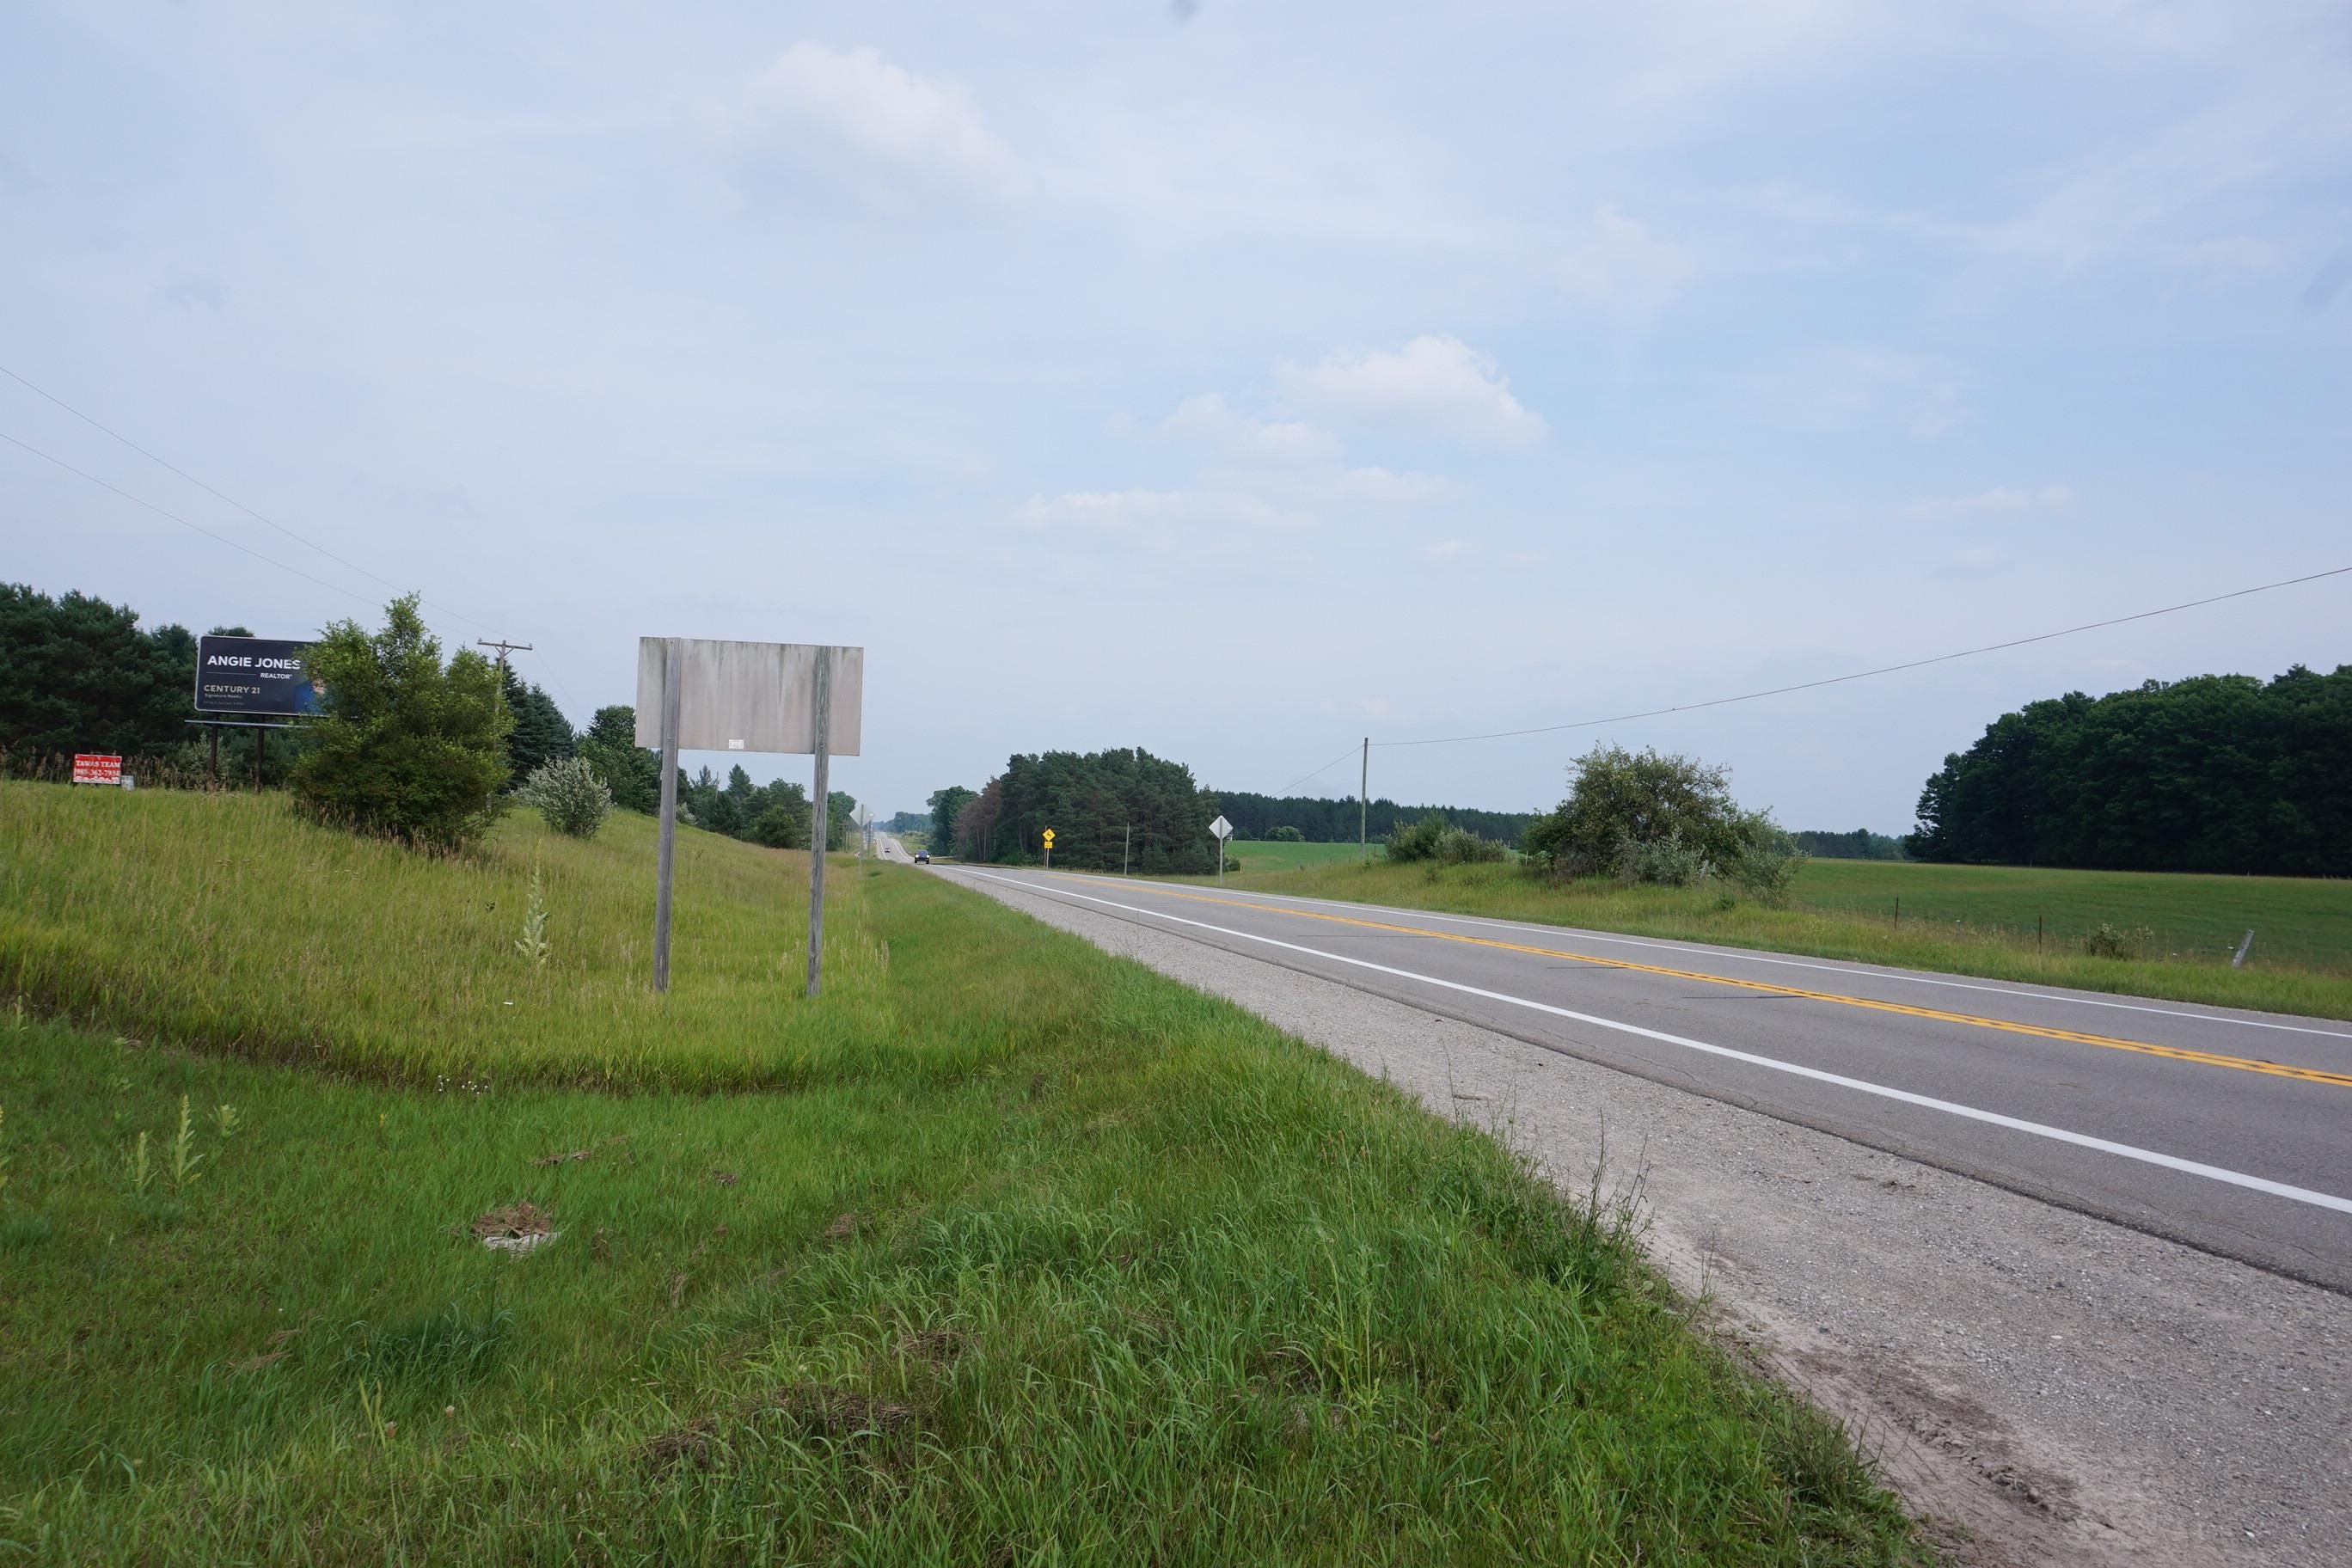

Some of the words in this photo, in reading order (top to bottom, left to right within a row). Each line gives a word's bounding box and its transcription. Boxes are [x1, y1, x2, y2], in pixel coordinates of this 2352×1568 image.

[207, 655, 252, 667] ANGIE
[254, 658, 301, 670] JONES
[204, 684, 249, 693] CENTURY
